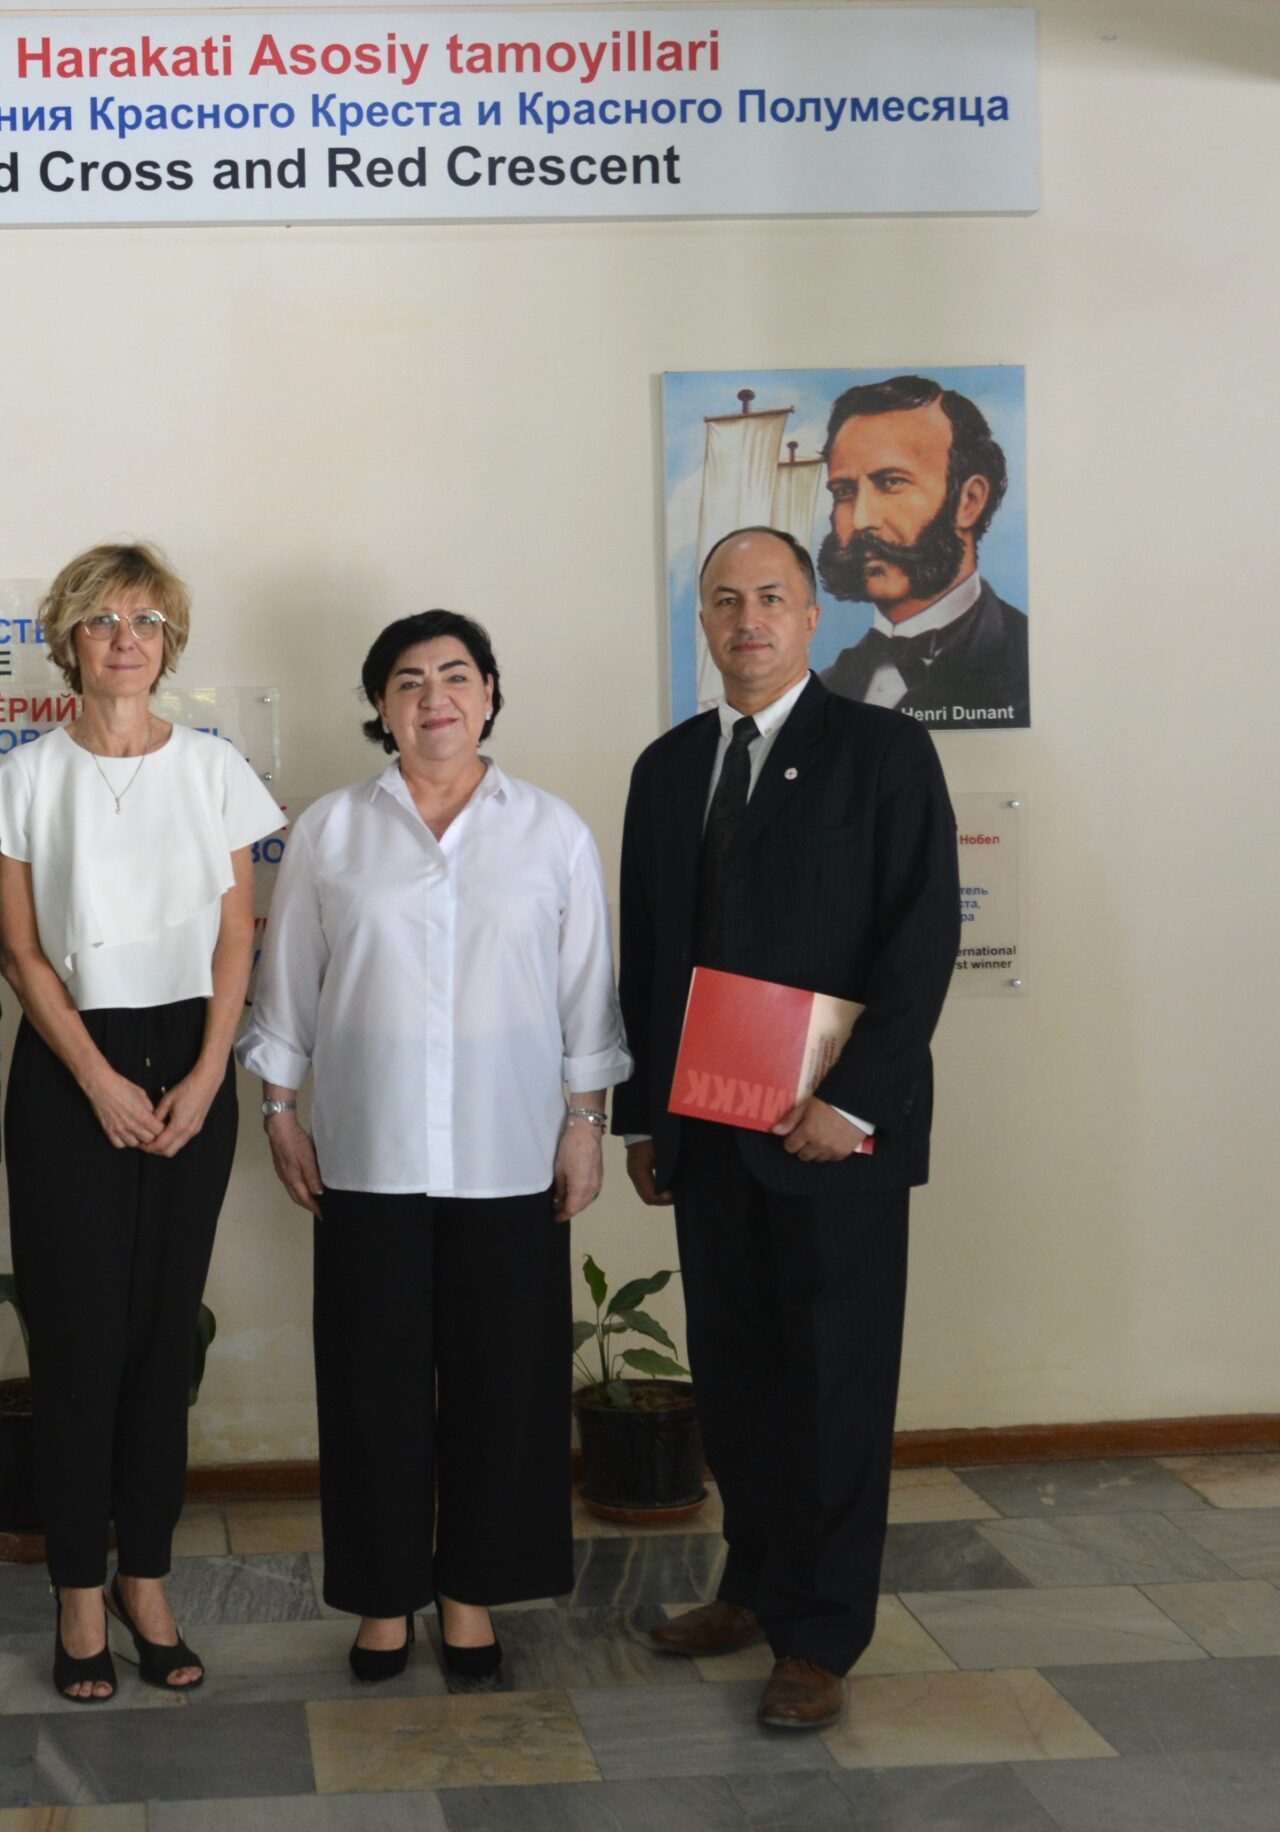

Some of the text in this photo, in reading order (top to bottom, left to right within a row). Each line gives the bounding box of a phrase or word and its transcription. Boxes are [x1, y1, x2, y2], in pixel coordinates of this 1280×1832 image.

[17, 34, 233, 79] Harakati
[249, 31, 430, 86] Asosiy
[447, 30, 720, 84] tamoyillari
[89, 95, 297, 141] Красного
[311, 92, 462, 138] Креста
[477, 100, 502, 127] и
[518, 90, 723, 135] Красного
[738, 88, 1010, 133] Полумесяца
[39, 150, 193, 192] Cross
[213, 148, 306, 190] and
[328, 146, 426, 188] Red
[447, 143, 681, 187] Crescent
[952, 705, 1015, 720] Dunant
[971, 959, 1013, 970] winner
